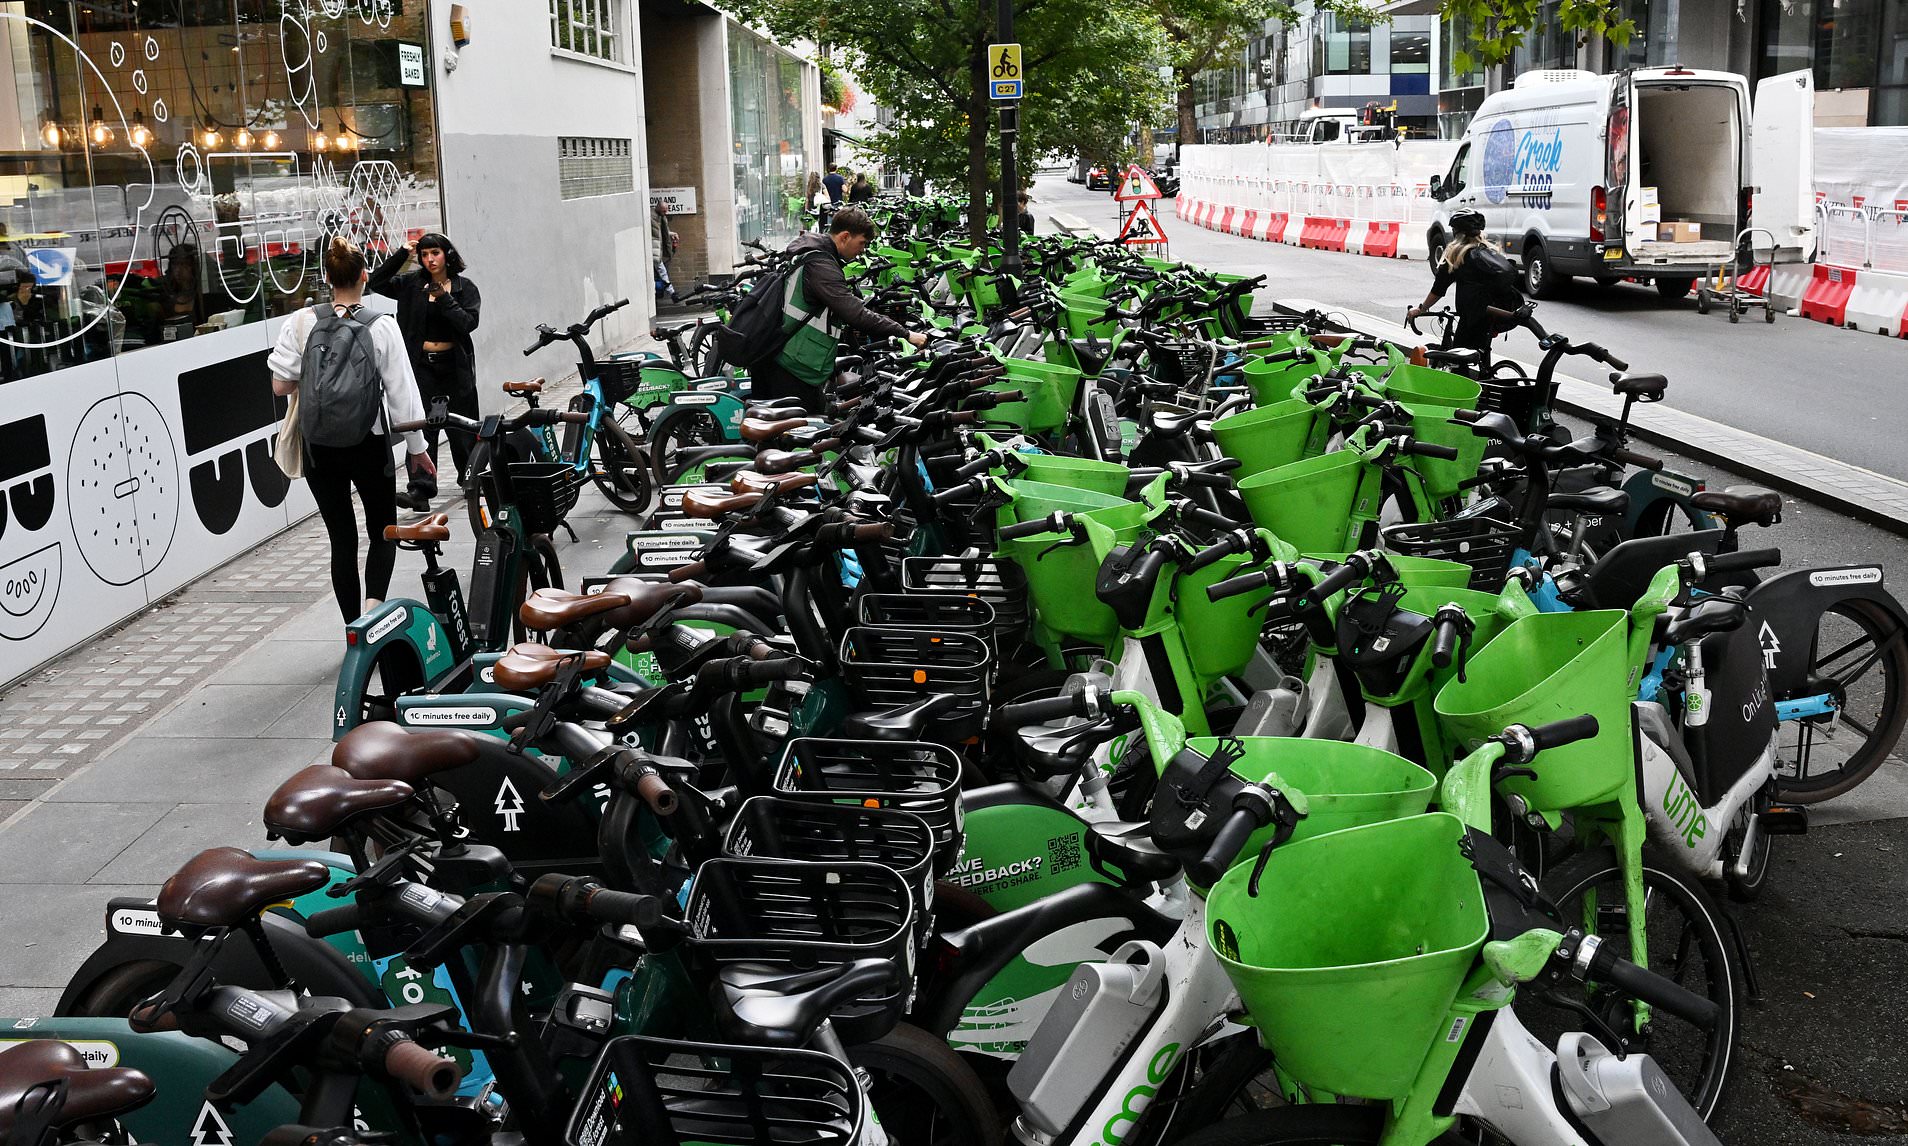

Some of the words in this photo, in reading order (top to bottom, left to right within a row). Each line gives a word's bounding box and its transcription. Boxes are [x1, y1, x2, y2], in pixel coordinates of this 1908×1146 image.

[1514, 127, 1562, 185] Greek
[1522, 173, 1553, 210] FOOD
[544, 426, 558, 462] forest
[1824, 574, 1849, 582] minutes
[448, 589, 469, 651] forest
[368, 631, 375, 639] 10
[374, 622, 390, 636] minutes
[422, 711, 453, 720] minutes
[454, 711, 470, 719] free
[472, 711, 491, 721] daily
[945, 857, 983, 876] AVE
[996, 880, 1009, 889] TO
[1010, 871, 1042, 887] SHARE.
[119, 916, 133, 926] 10
[135, 917, 163, 928] minut
[81, 1051, 108, 1063] daily
